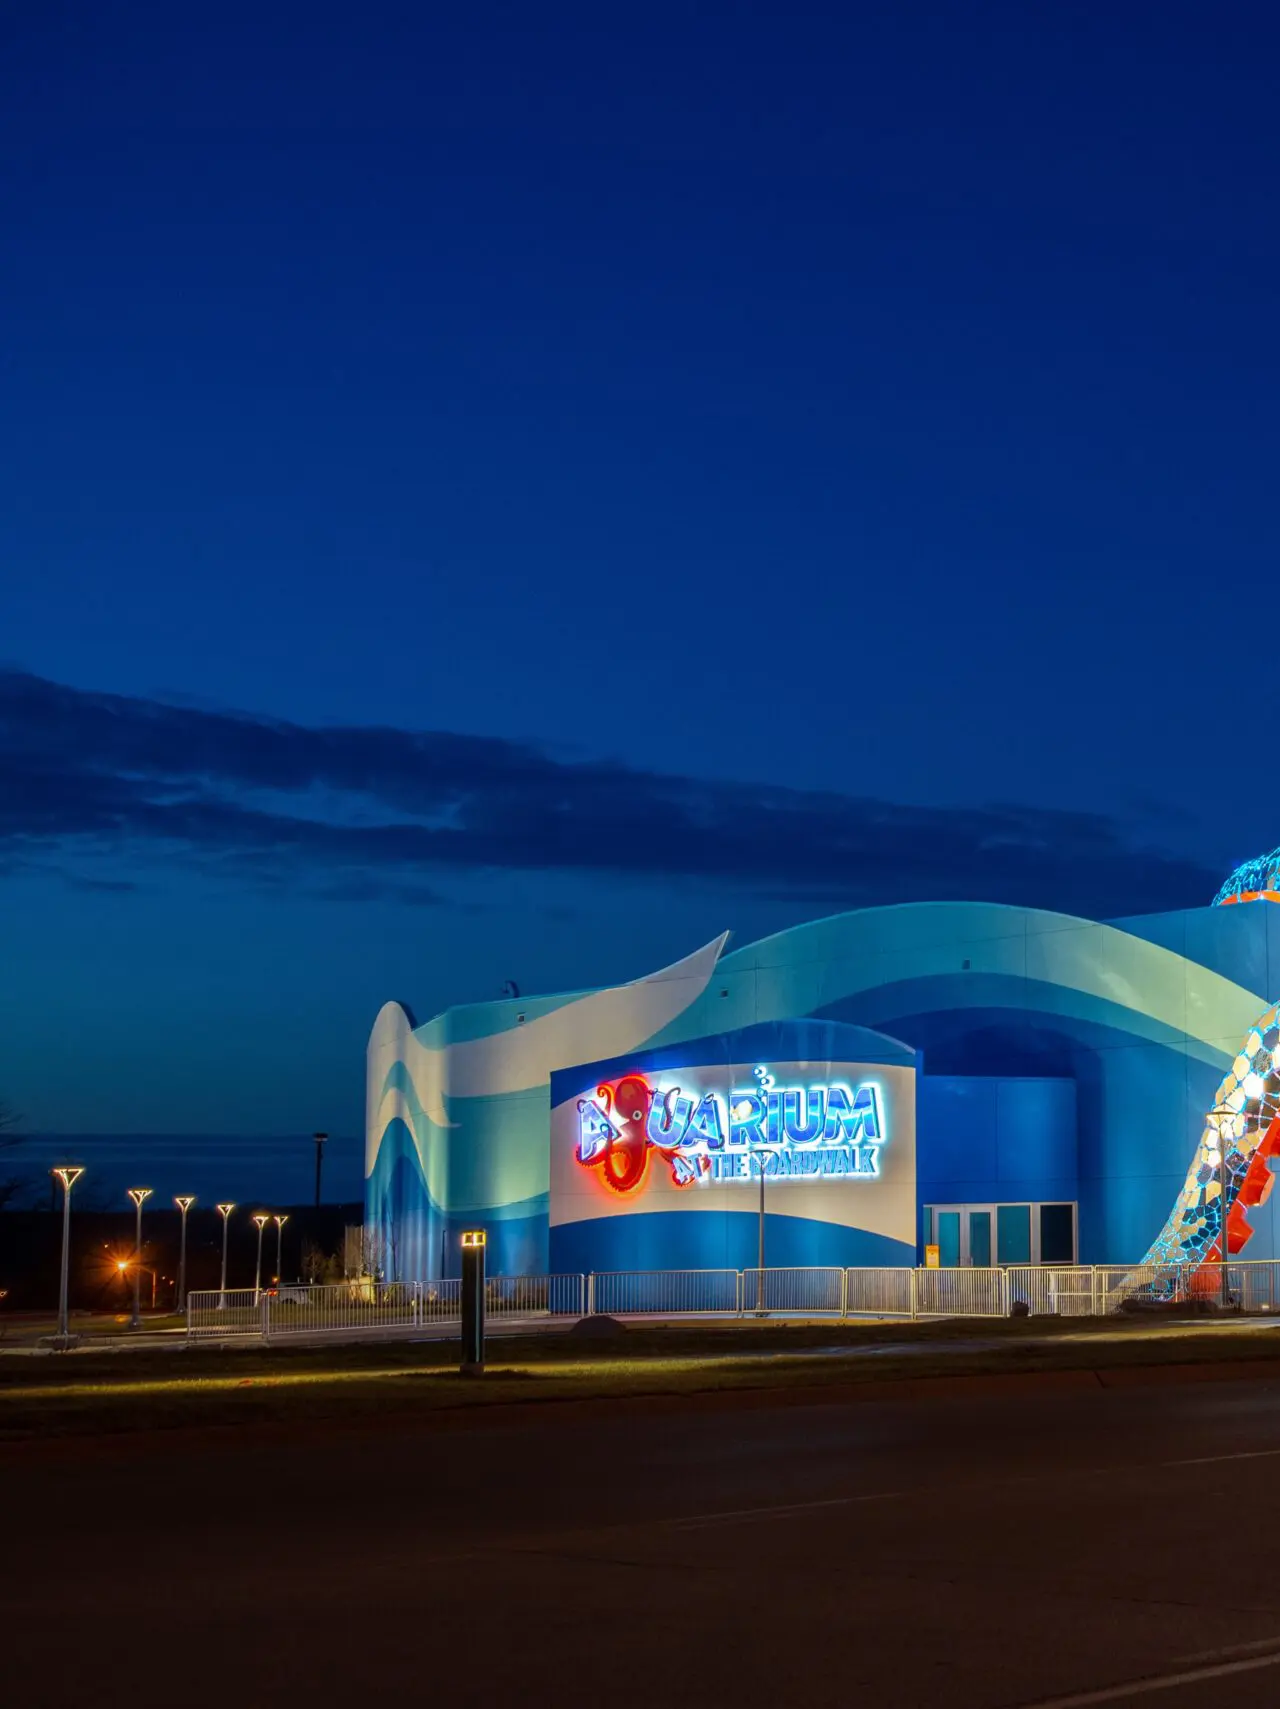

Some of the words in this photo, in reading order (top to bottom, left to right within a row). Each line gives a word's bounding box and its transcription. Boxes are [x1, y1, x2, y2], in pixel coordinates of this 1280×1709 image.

[674, 1154, 703, 1184] AT
[711, 1153, 747, 1178] THE
[750, 1148, 876, 1176] BOARDWALK
